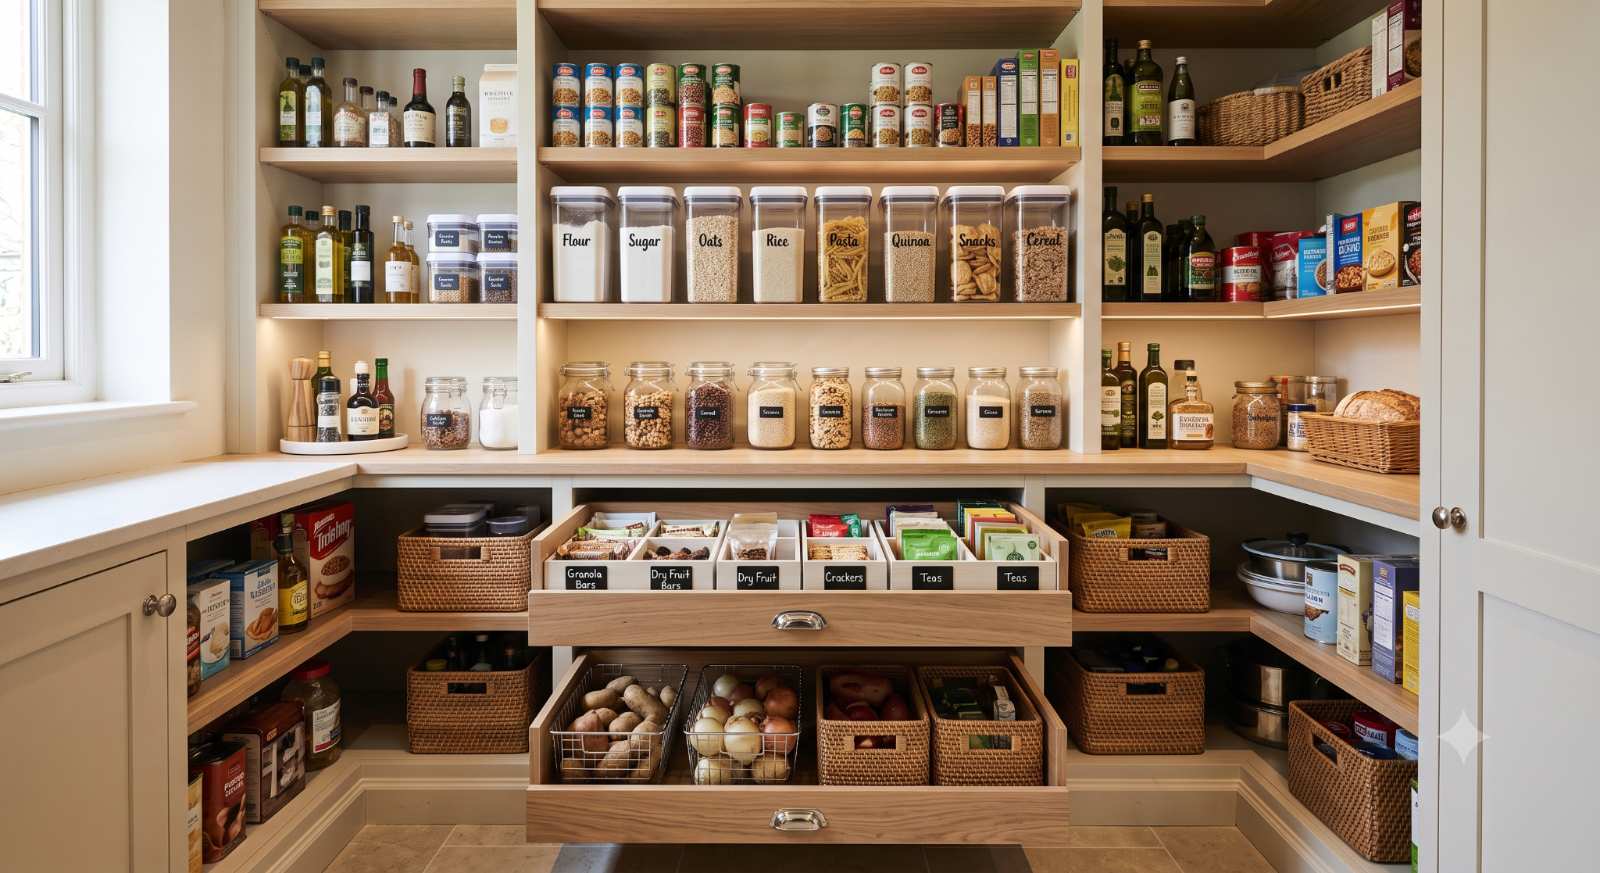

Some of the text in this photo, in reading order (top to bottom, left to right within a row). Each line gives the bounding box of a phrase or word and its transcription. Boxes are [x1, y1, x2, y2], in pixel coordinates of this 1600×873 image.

[562, 233, 591, 247] Flour
[628, 233, 661, 251] Sugar
[698, 233, 723, 247] Oats
[766, 233, 789, 247] Rice
[829, 232, 860, 247] Pasta
[891, 233, 931, 248] Quinoa
[959, 233, 996, 247] Snacks
[1027, 232, 1062, 246] Cereal
[567, 568, 603, 579] Granola
[651, 569, 690, 581] Dry Fruit
[738, 572, 777, 586] Dry Fruit
[825, 571, 864, 583] Crackers
[919, 572, 942, 583] Teas
[1004, 572, 1027, 583] Teas
[575, 579, 597, 590] Bars
[661, 581, 681, 590] Bars
